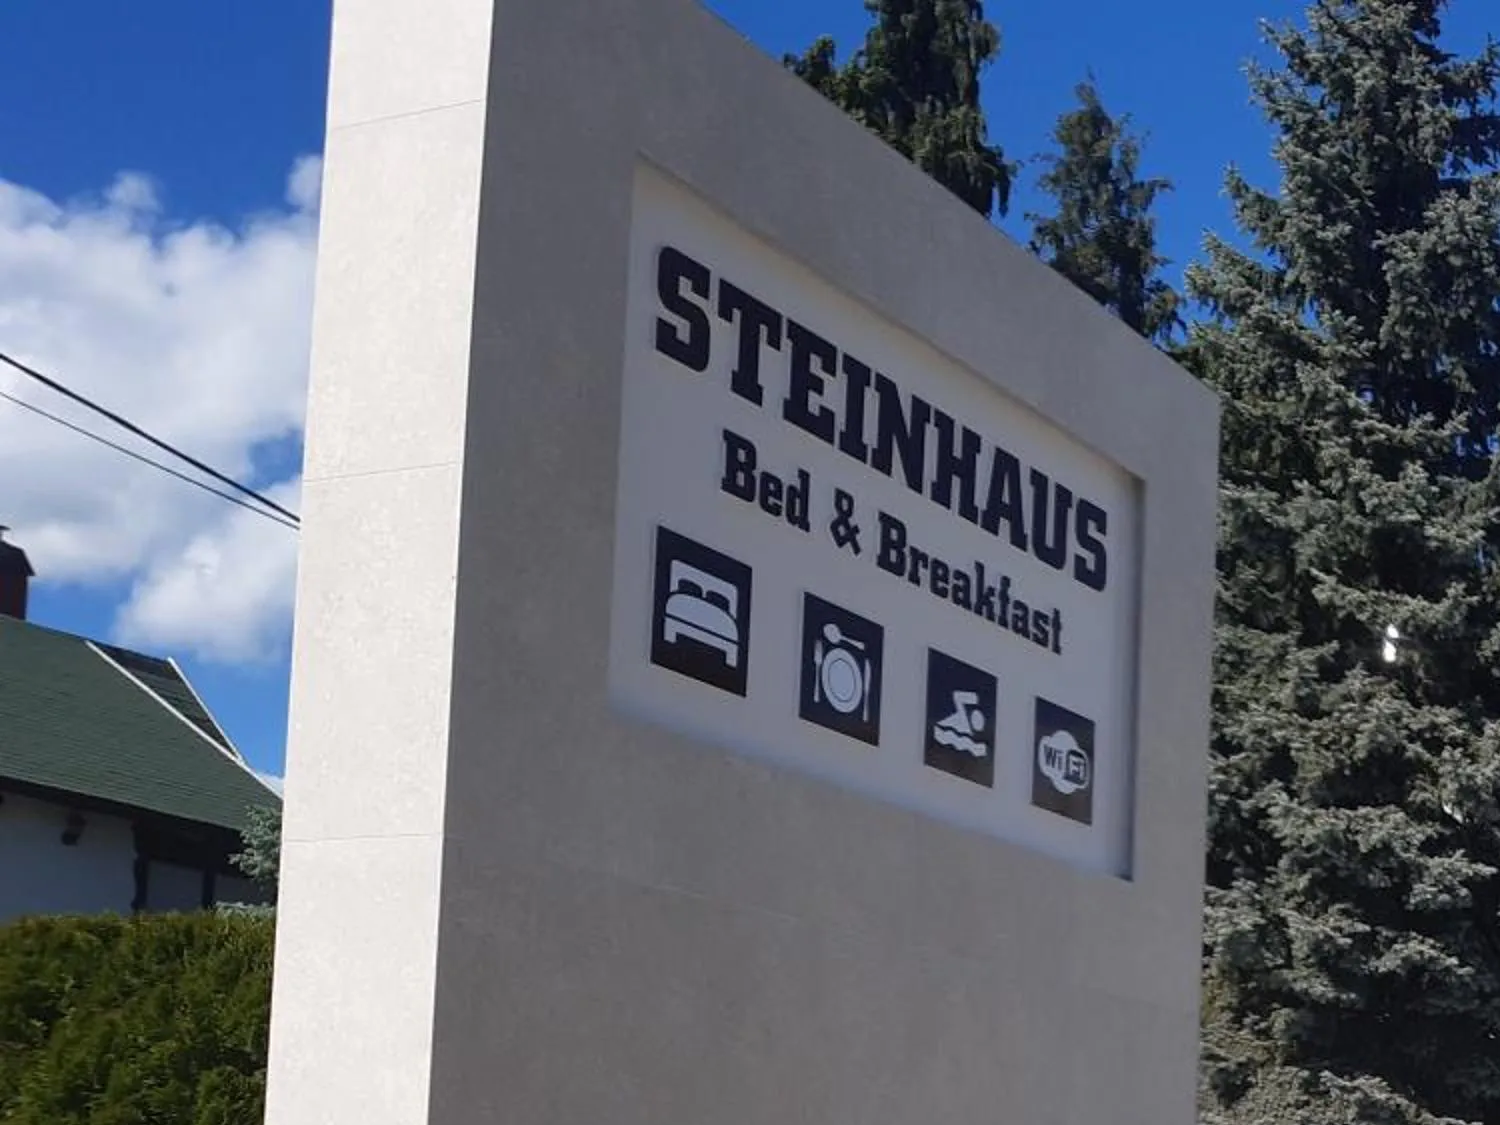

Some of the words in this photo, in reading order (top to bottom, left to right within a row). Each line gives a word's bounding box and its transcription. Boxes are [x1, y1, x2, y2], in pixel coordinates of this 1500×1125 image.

[656, 246, 1107, 592] STEINHAUS
[721, 429, 810, 532] Bed
[829, 488, 863, 556] &
[876, 511, 1063, 655] Breakfast
